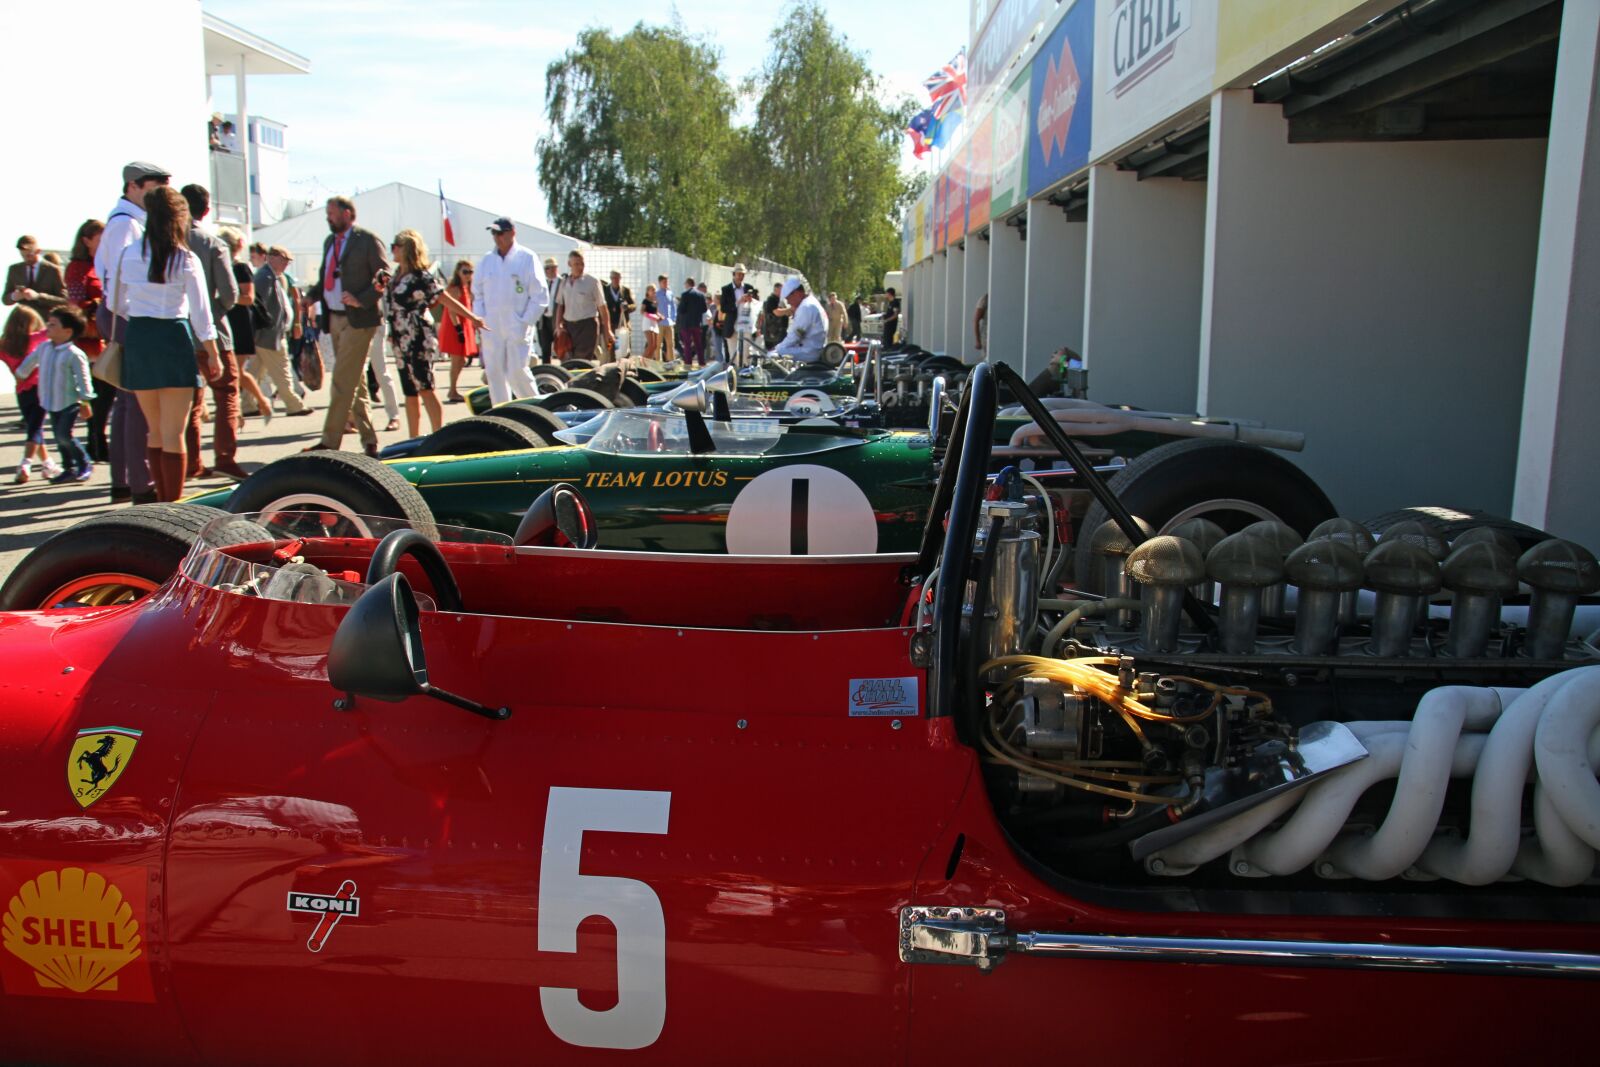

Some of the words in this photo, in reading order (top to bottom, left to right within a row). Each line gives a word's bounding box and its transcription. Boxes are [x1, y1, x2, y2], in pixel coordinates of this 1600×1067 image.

[584, 472, 644, 488] TEAM
[652, 471, 729, 488] LOTUS
[790, 478, 809, 555] 1
[864, 689, 907, 702] HALL
[295, 896, 353, 912] KONI
[537, 786, 672, 1050] 5
[22, 916, 124, 950] SHELL
